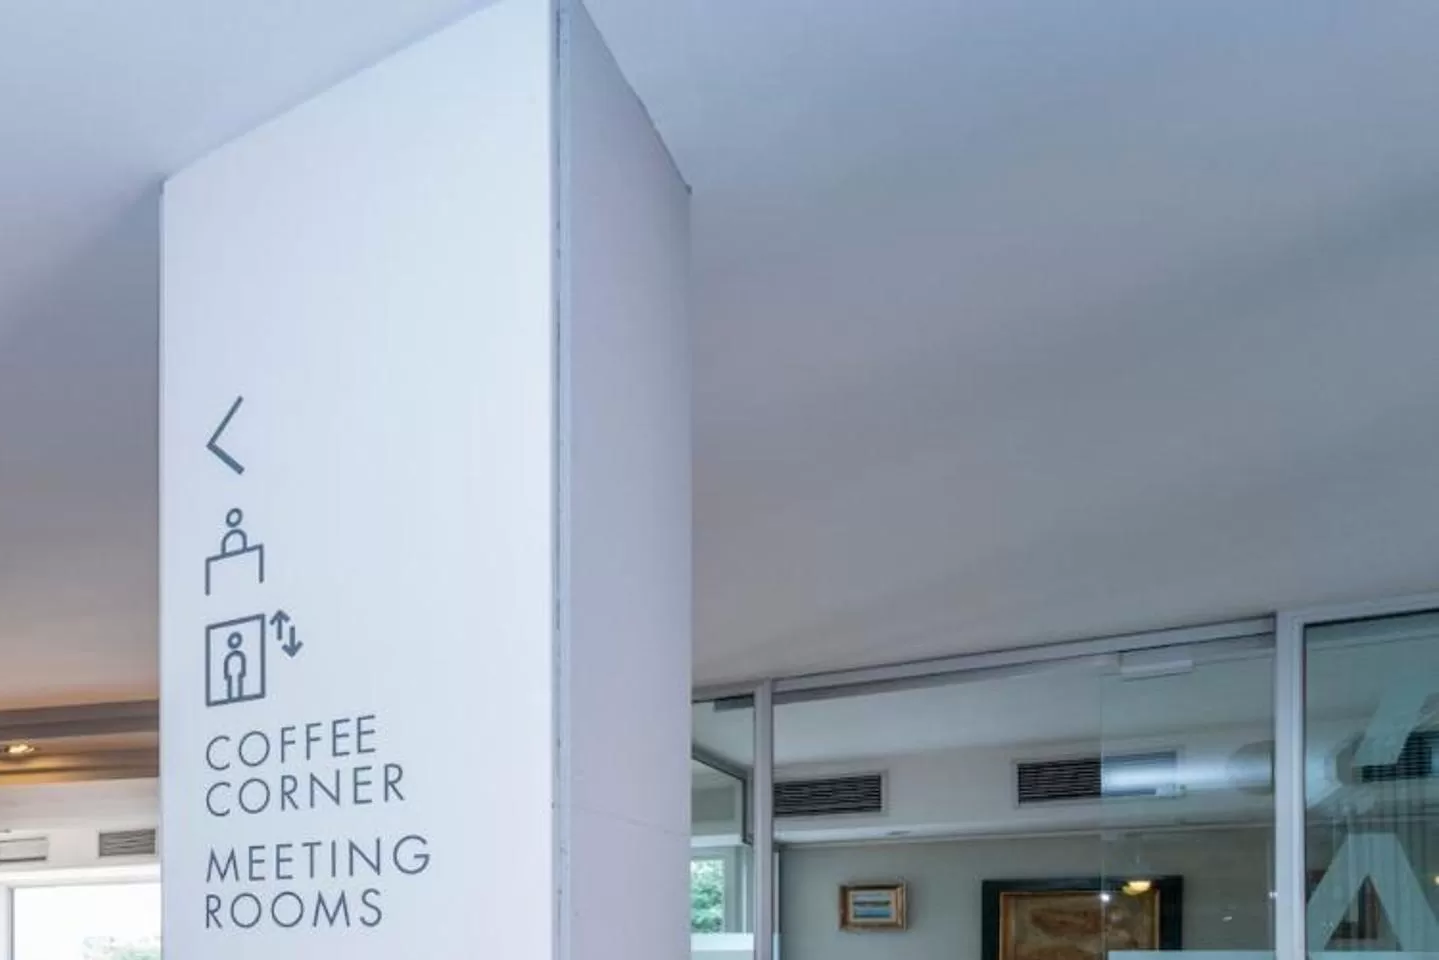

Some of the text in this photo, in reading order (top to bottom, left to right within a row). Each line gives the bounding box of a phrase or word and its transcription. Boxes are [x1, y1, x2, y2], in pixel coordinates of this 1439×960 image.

[205, 714, 376, 771] COFFEE
[205, 763, 405, 817] CORNER
[205, 834, 430, 883] MEETING
[205, 888, 383, 929] ROOMS
